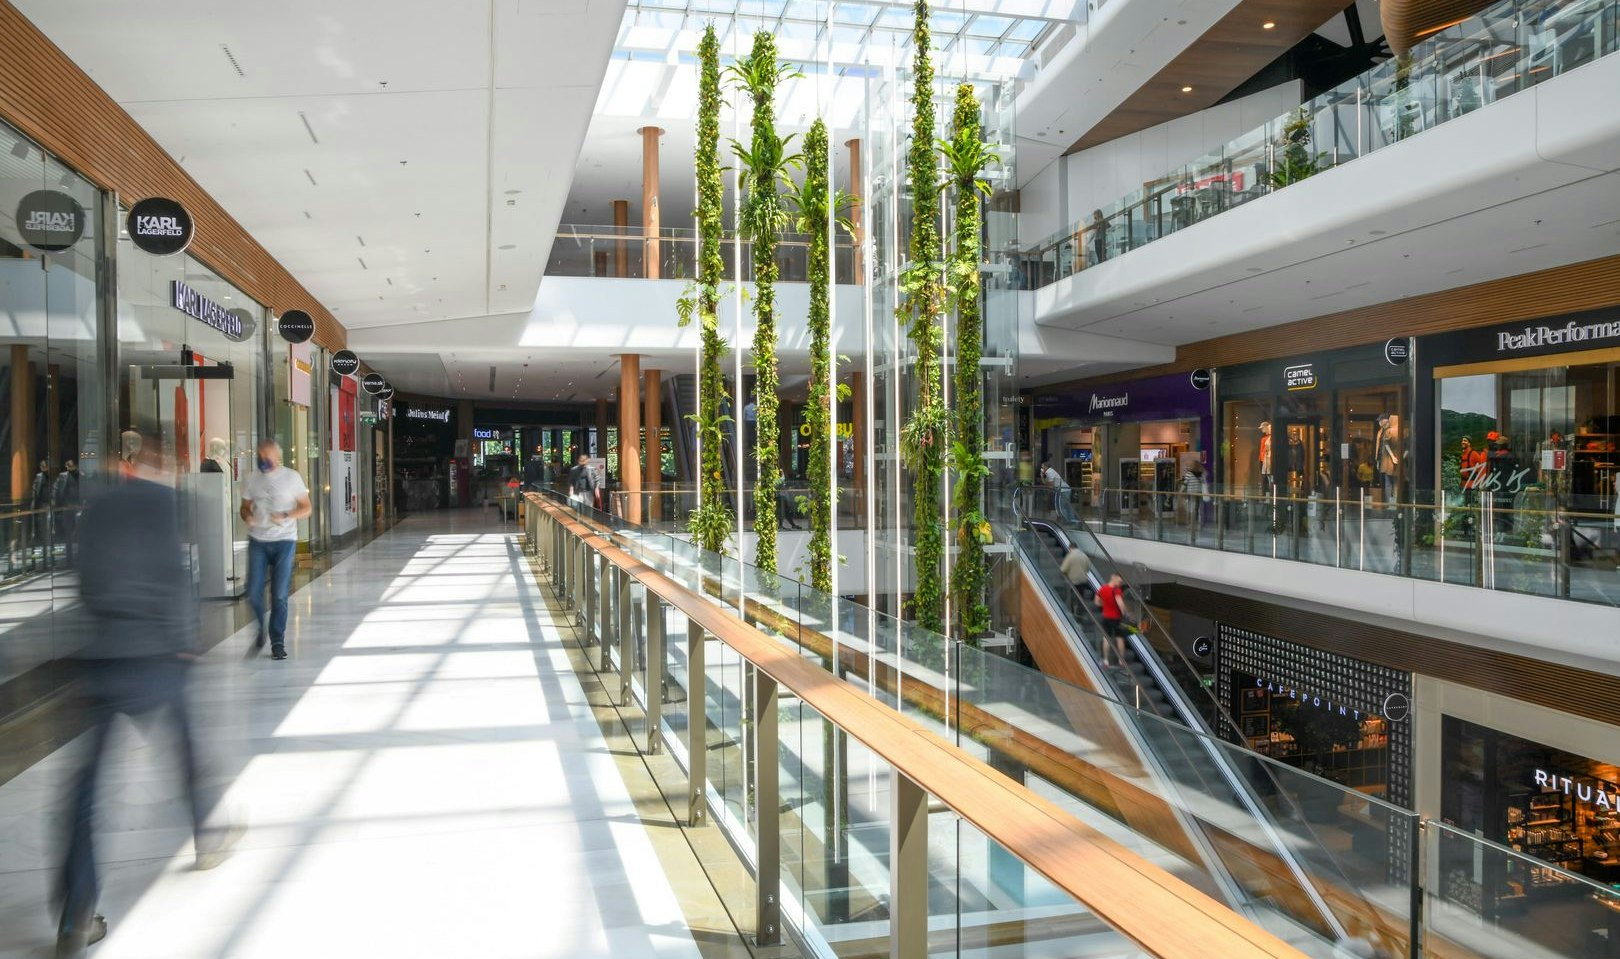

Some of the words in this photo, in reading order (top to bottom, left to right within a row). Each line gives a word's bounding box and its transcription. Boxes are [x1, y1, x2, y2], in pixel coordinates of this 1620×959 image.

[137, 216, 182, 230] KARL
[137, 228, 183, 236] LAGERFELD
[175, 280, 199, 320] KARL
[199, 294, 242, 339] LAGERFELD
[1287, 369, 1313, 378] camel
[1287, 376, 1313, 386] active
[1088, 392, 1129, 414] Marionnaud
[407, 409, 428, 418] Julius
[428, 410, 445, 420] Meinl
[473, 428, 492, 438] food
[1459, 461, 1502, 494] This
[1506, 463, 1531, 493] is
